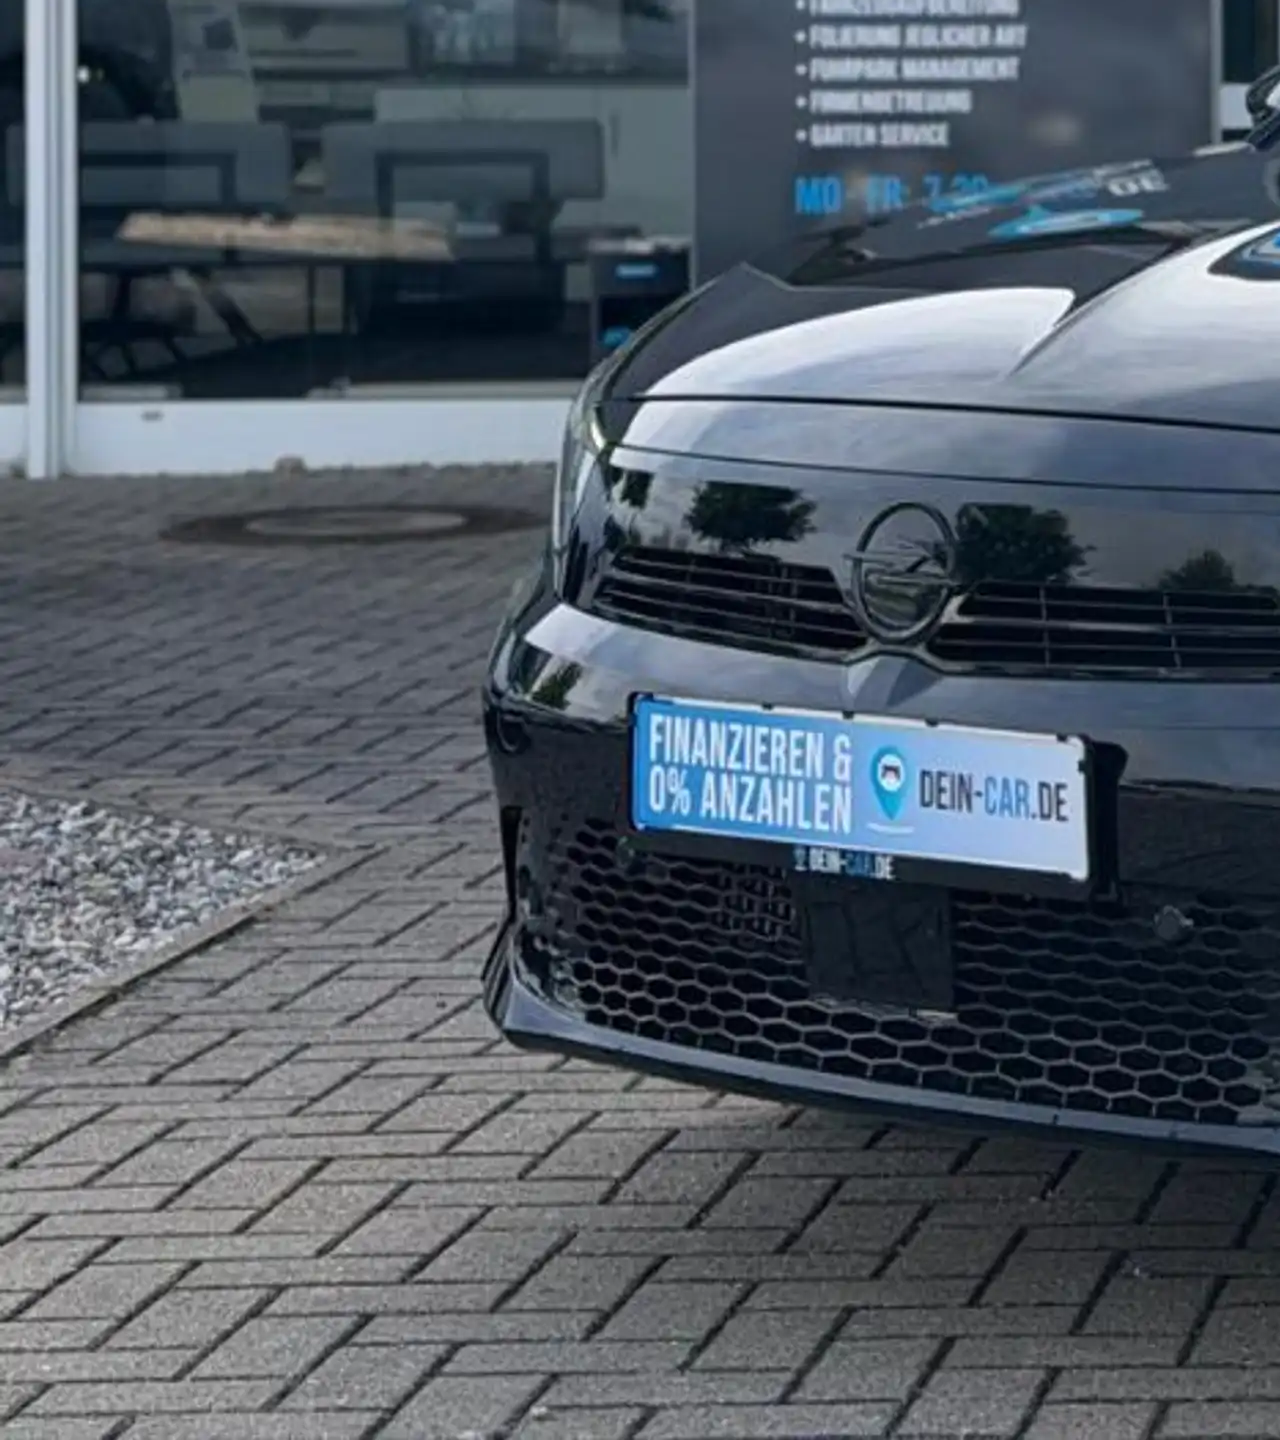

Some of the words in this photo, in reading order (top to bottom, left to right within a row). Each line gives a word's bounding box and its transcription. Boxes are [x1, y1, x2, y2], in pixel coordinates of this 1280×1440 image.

[649, 712, 824, 779] FINANZIEREN
[834, 734, 853, 777] &
[648, 764, 690, 818] 0%
[699, 773, 853, 835] ANZAHLEN
[918, 768, 1070, 823] DEIN-CAR.DE
